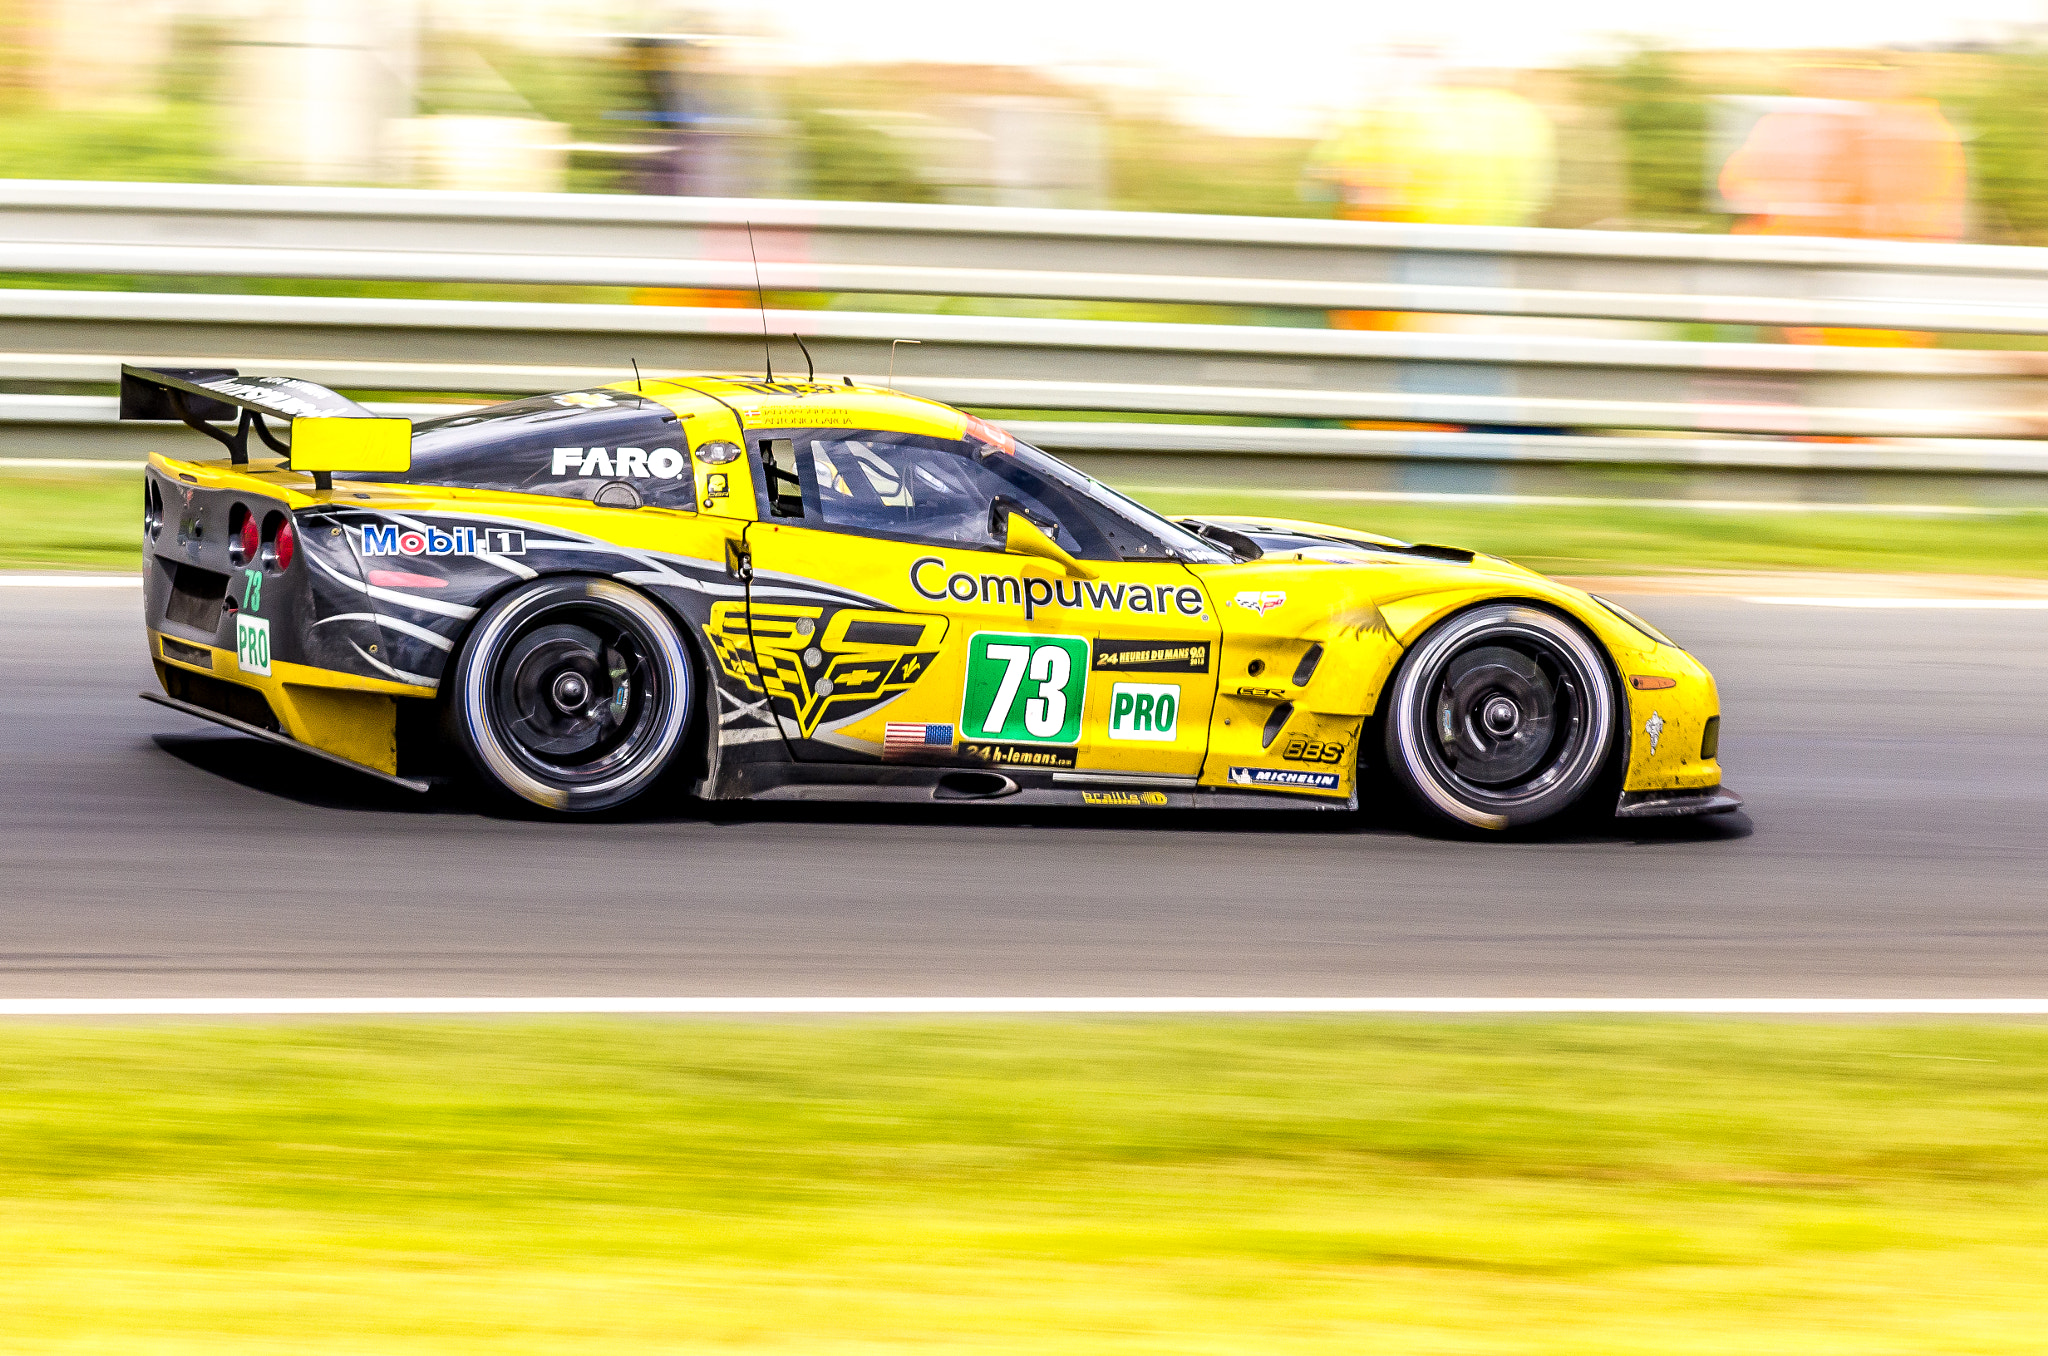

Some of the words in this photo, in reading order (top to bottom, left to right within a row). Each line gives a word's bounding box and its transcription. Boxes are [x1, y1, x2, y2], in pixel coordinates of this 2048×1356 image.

[764, 417, 813, 425] ANTONIO
[815, 417, 853, 425] GARCIA
[551, 447, 684, 479] FARO
[362, 525, 477, 556] Mobil
[243, 569, 262, 612] 73
[910, 556, 1204, 620] Compuware
[239, 624, 268, 668] PRO
[1097, 652, 1118, 666] 24
[1119, 650, 1150, 663] HEURES
[1151, 649, 1164, 661] DU
[1164, 647, 1190, 660] MANS
[981, 643, 1071, 738] 73
[1113, 692, 1176, 732] PRO
[967, 745, 992, 761] 24
[1283, 740, 1344, 764] BBS
[1255, 771, 1335, 786] MICHELIN
